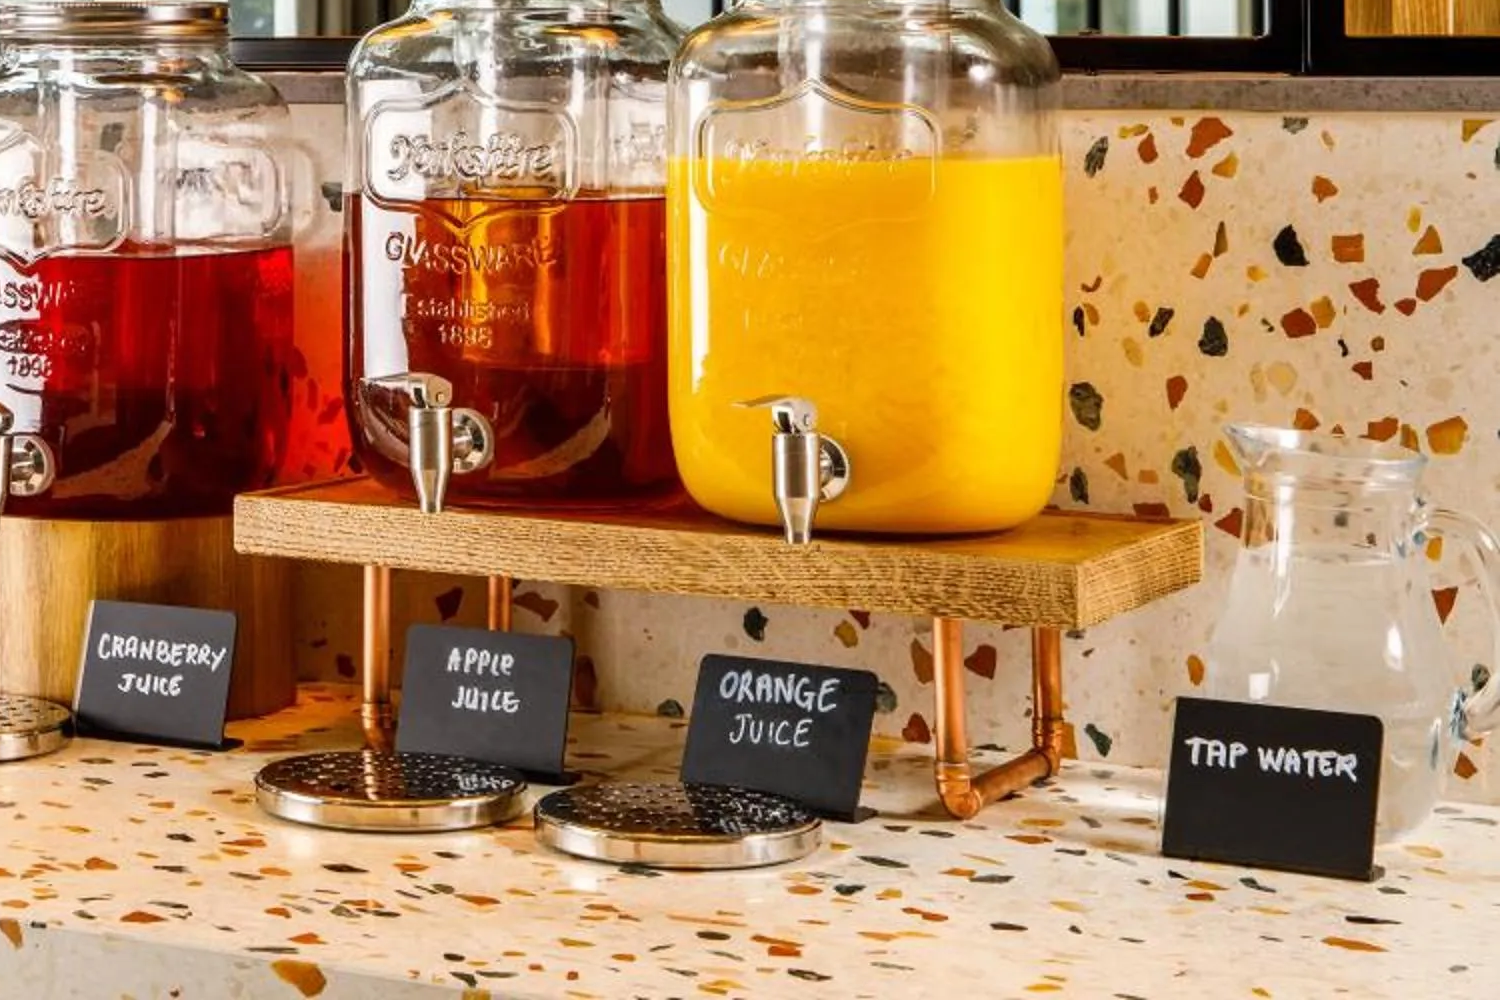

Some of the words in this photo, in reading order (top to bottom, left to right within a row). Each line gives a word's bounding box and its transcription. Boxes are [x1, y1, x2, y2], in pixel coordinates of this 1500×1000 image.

[97, 632, 227, 673] CRANBERRY
[117, 673, 184, 697] JUICE
[451, 685, 521, 714] JUICE
[719, 669, 841, 712] ORANGE
[728, 713, 814, 748] JUICE
[1184, 736, 1249, 769] TAP
[1257, 746, 1358, 783] WATER
